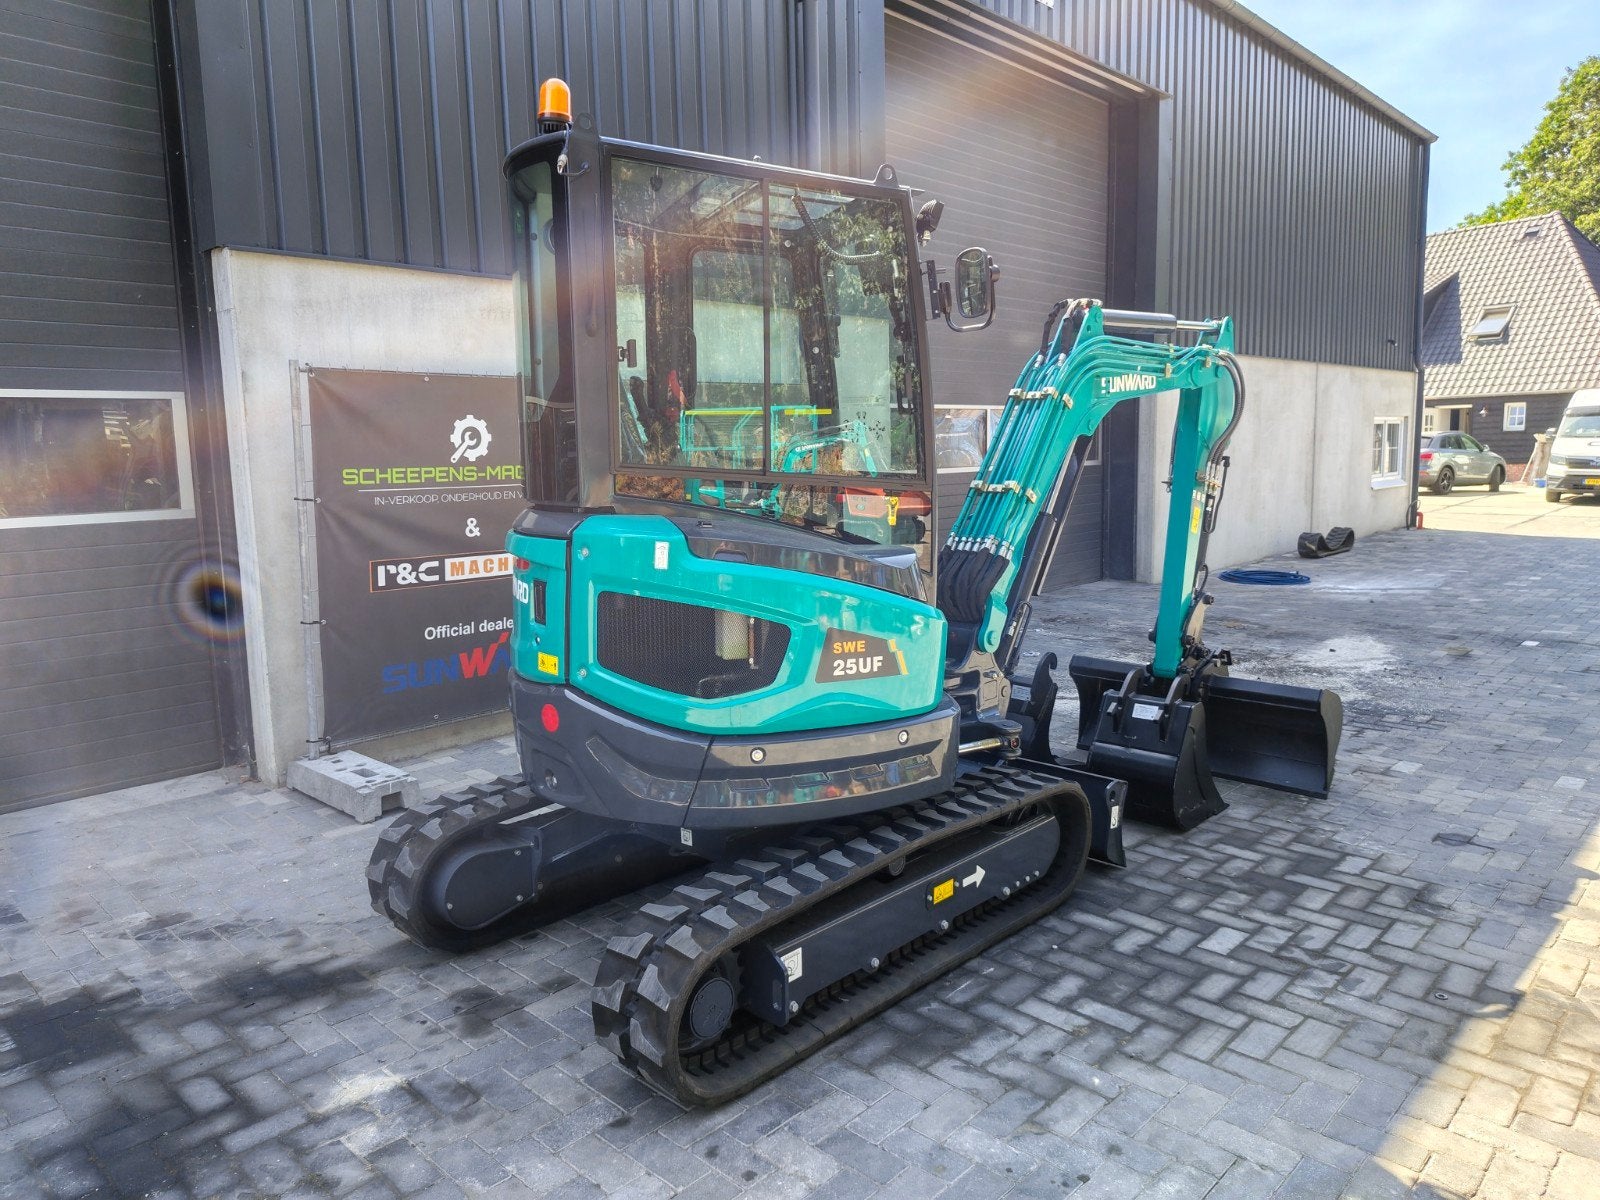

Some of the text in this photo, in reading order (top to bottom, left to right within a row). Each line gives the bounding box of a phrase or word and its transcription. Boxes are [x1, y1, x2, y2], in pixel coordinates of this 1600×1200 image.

[465, 517, 481, 538] &
[450, 557, 517, 577] MACH
[424, 621, 475, 640] Official
[833, 640, 866, 654] SWE
[833, 656, 883, 676] 25UF
